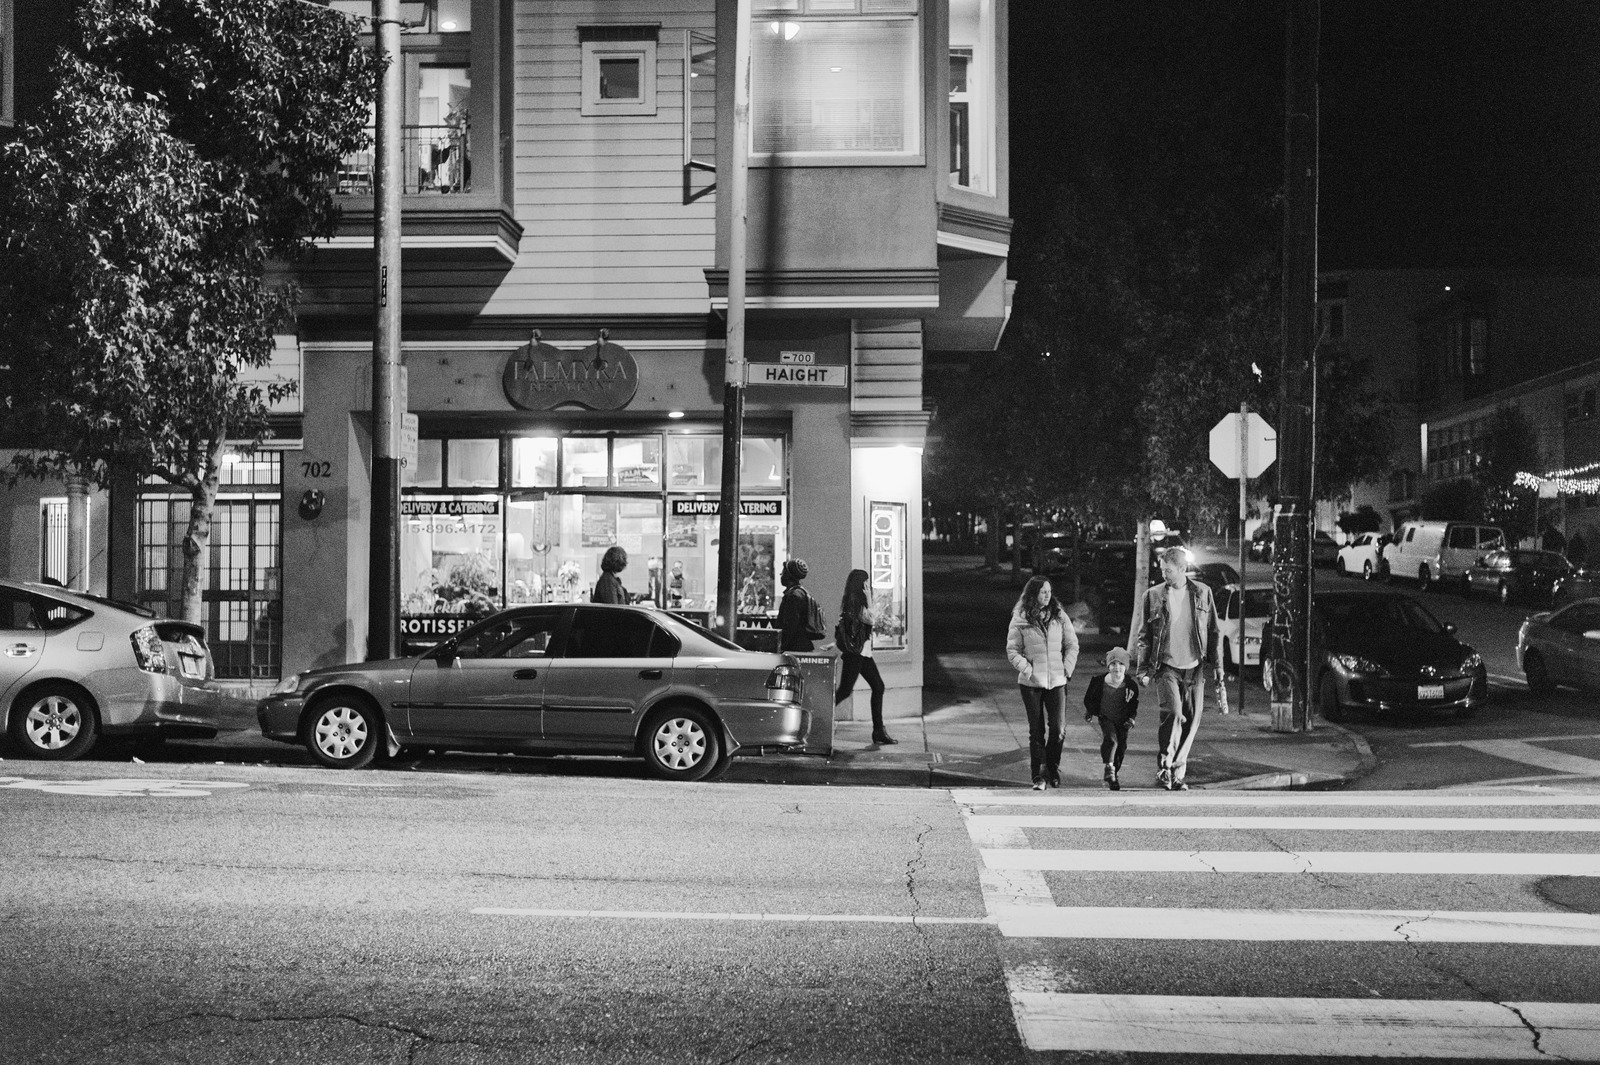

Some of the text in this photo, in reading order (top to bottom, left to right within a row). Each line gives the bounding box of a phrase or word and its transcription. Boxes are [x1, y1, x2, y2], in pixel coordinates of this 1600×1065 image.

[792, 353, 812, 362] 700
[514, 360, 627, 380] PALMYRA
[766, 367, 828, 382] HAIGHT
[302, 461, 331, 478] 702
[440, 502, 447, 513] &
[449, 502, 494, 513] CATERING
[677, 502, 720, 513] DELIVERY
[874, 514, 892, 583] OPEN
